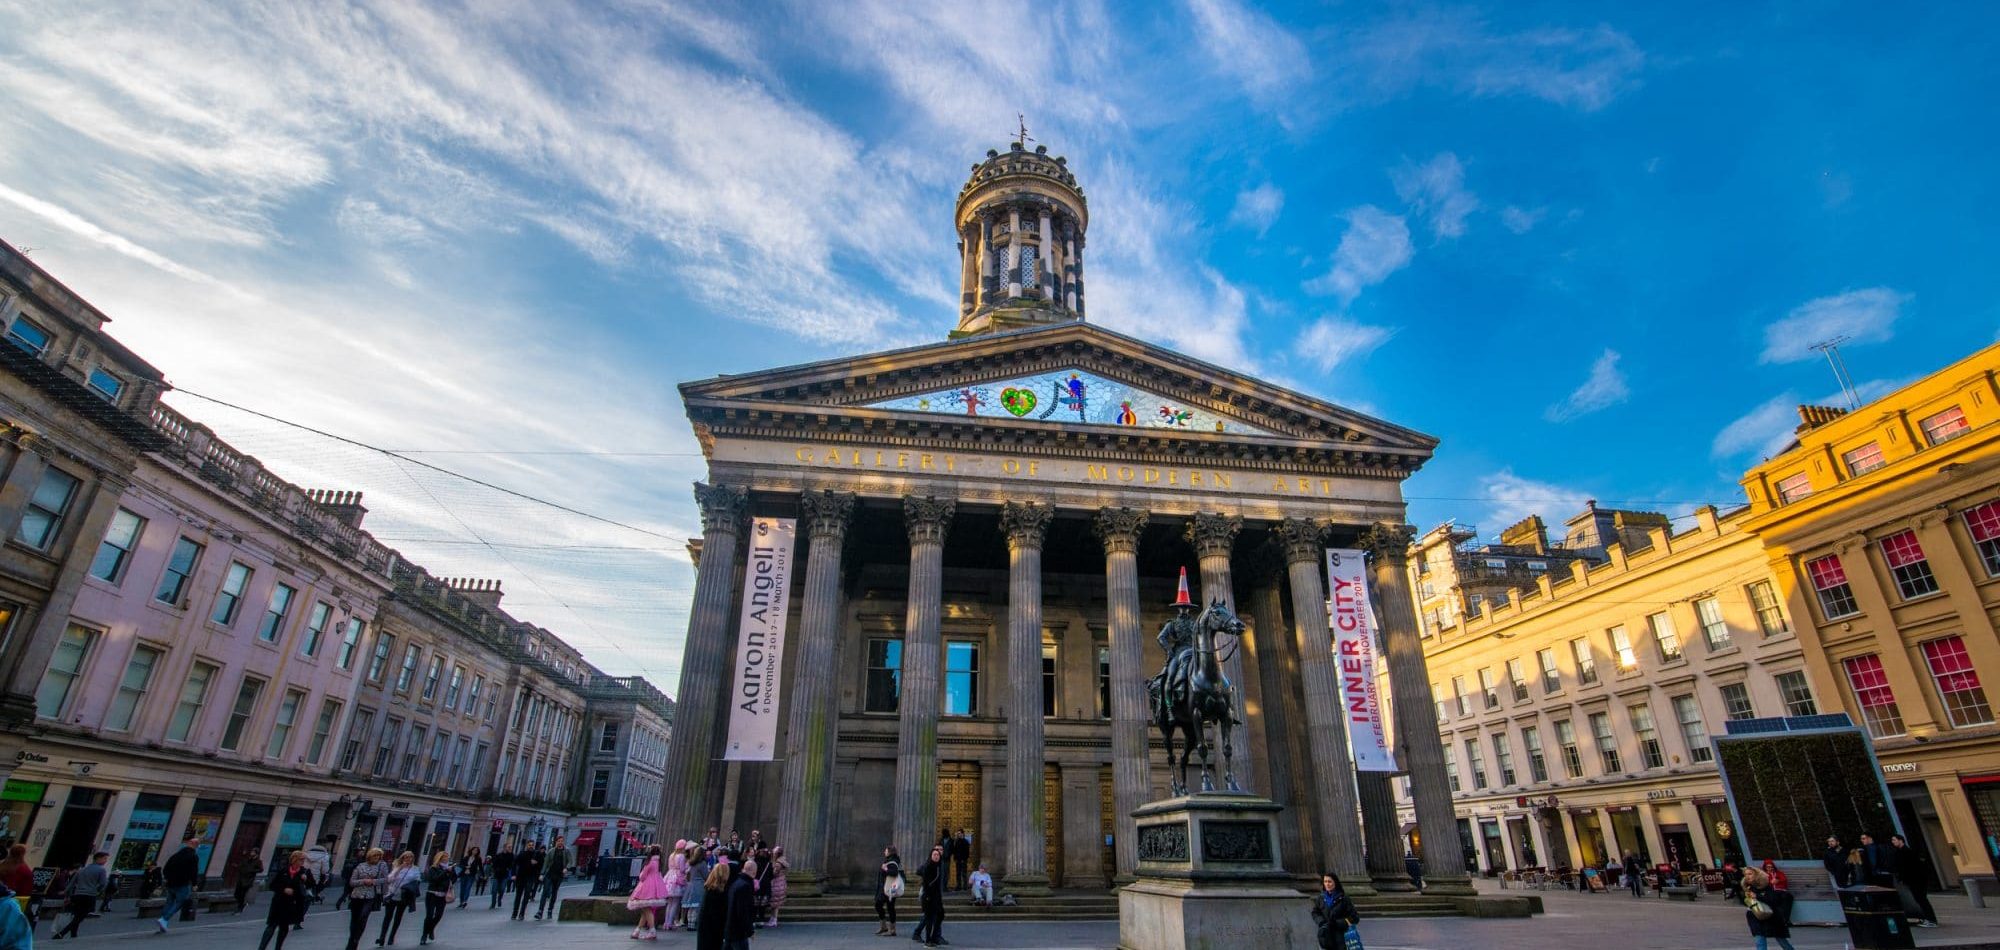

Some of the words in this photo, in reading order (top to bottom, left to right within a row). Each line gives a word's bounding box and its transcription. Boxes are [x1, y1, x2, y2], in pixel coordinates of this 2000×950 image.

[796, 446, 957, 472] GALLERY
[1002, 459, 1041, 476] OF
[1087, 464, 1231, 489] MODERN
[1273, 476, 1332, 496] ART
[778, 547, 786, 571] 2018
[750, 547, 774, 624] Angell
[774, 574, 783, 603] March
[1333, 576, 1357, 631] CITY
[1353, 575, 1364, 597] 2018
[1356, 600, 1371, 655] NOVEMBER
[741, 632, 765, 716] Aaron
[764, 654, 775, 705] December
[1341, 640, 1370, 722] INNER
[1366, 680, 1382, 736] FEBRUARY
[1376, 738, 1385, 748] 15
[1883, 762, 1917, 772] money
